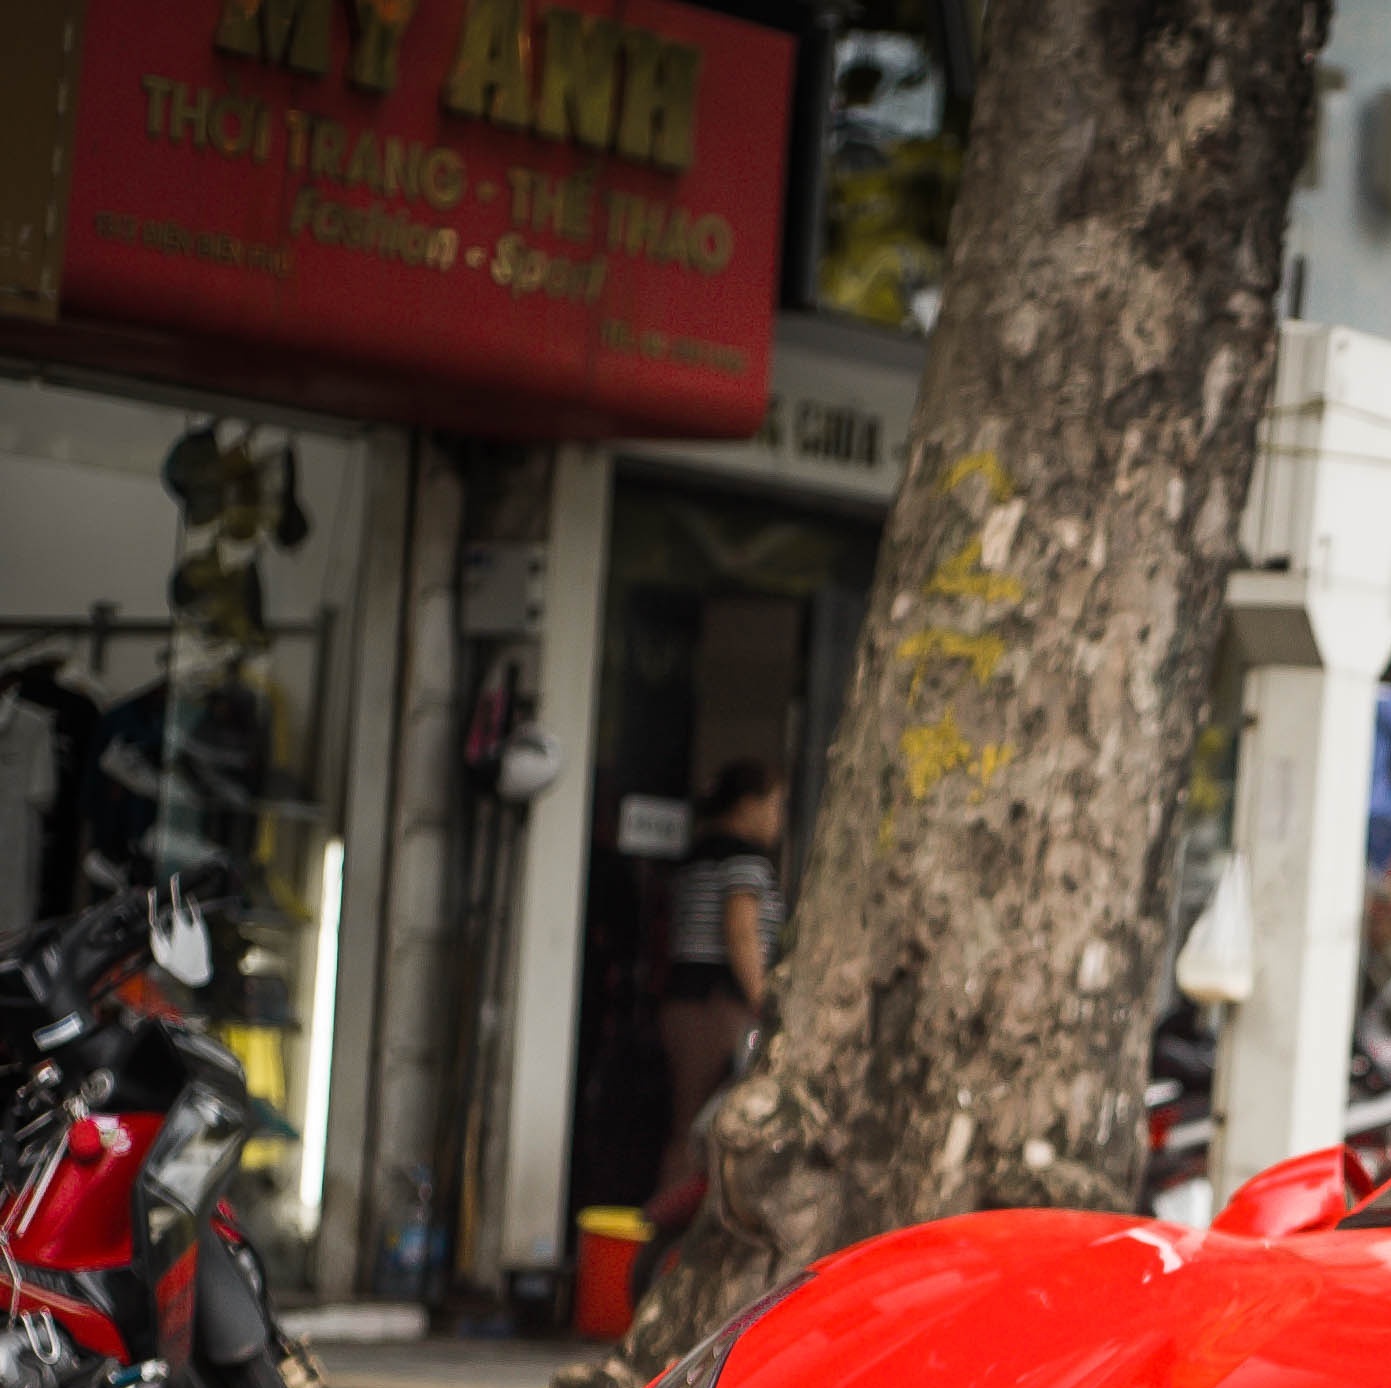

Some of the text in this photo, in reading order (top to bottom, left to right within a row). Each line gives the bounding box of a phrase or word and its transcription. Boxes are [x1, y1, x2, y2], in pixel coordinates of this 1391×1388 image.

[442, 0, 704, 174] ANH
[285, 107, 467, 212] TRANG
[605, 190, 735, 275] THAO
